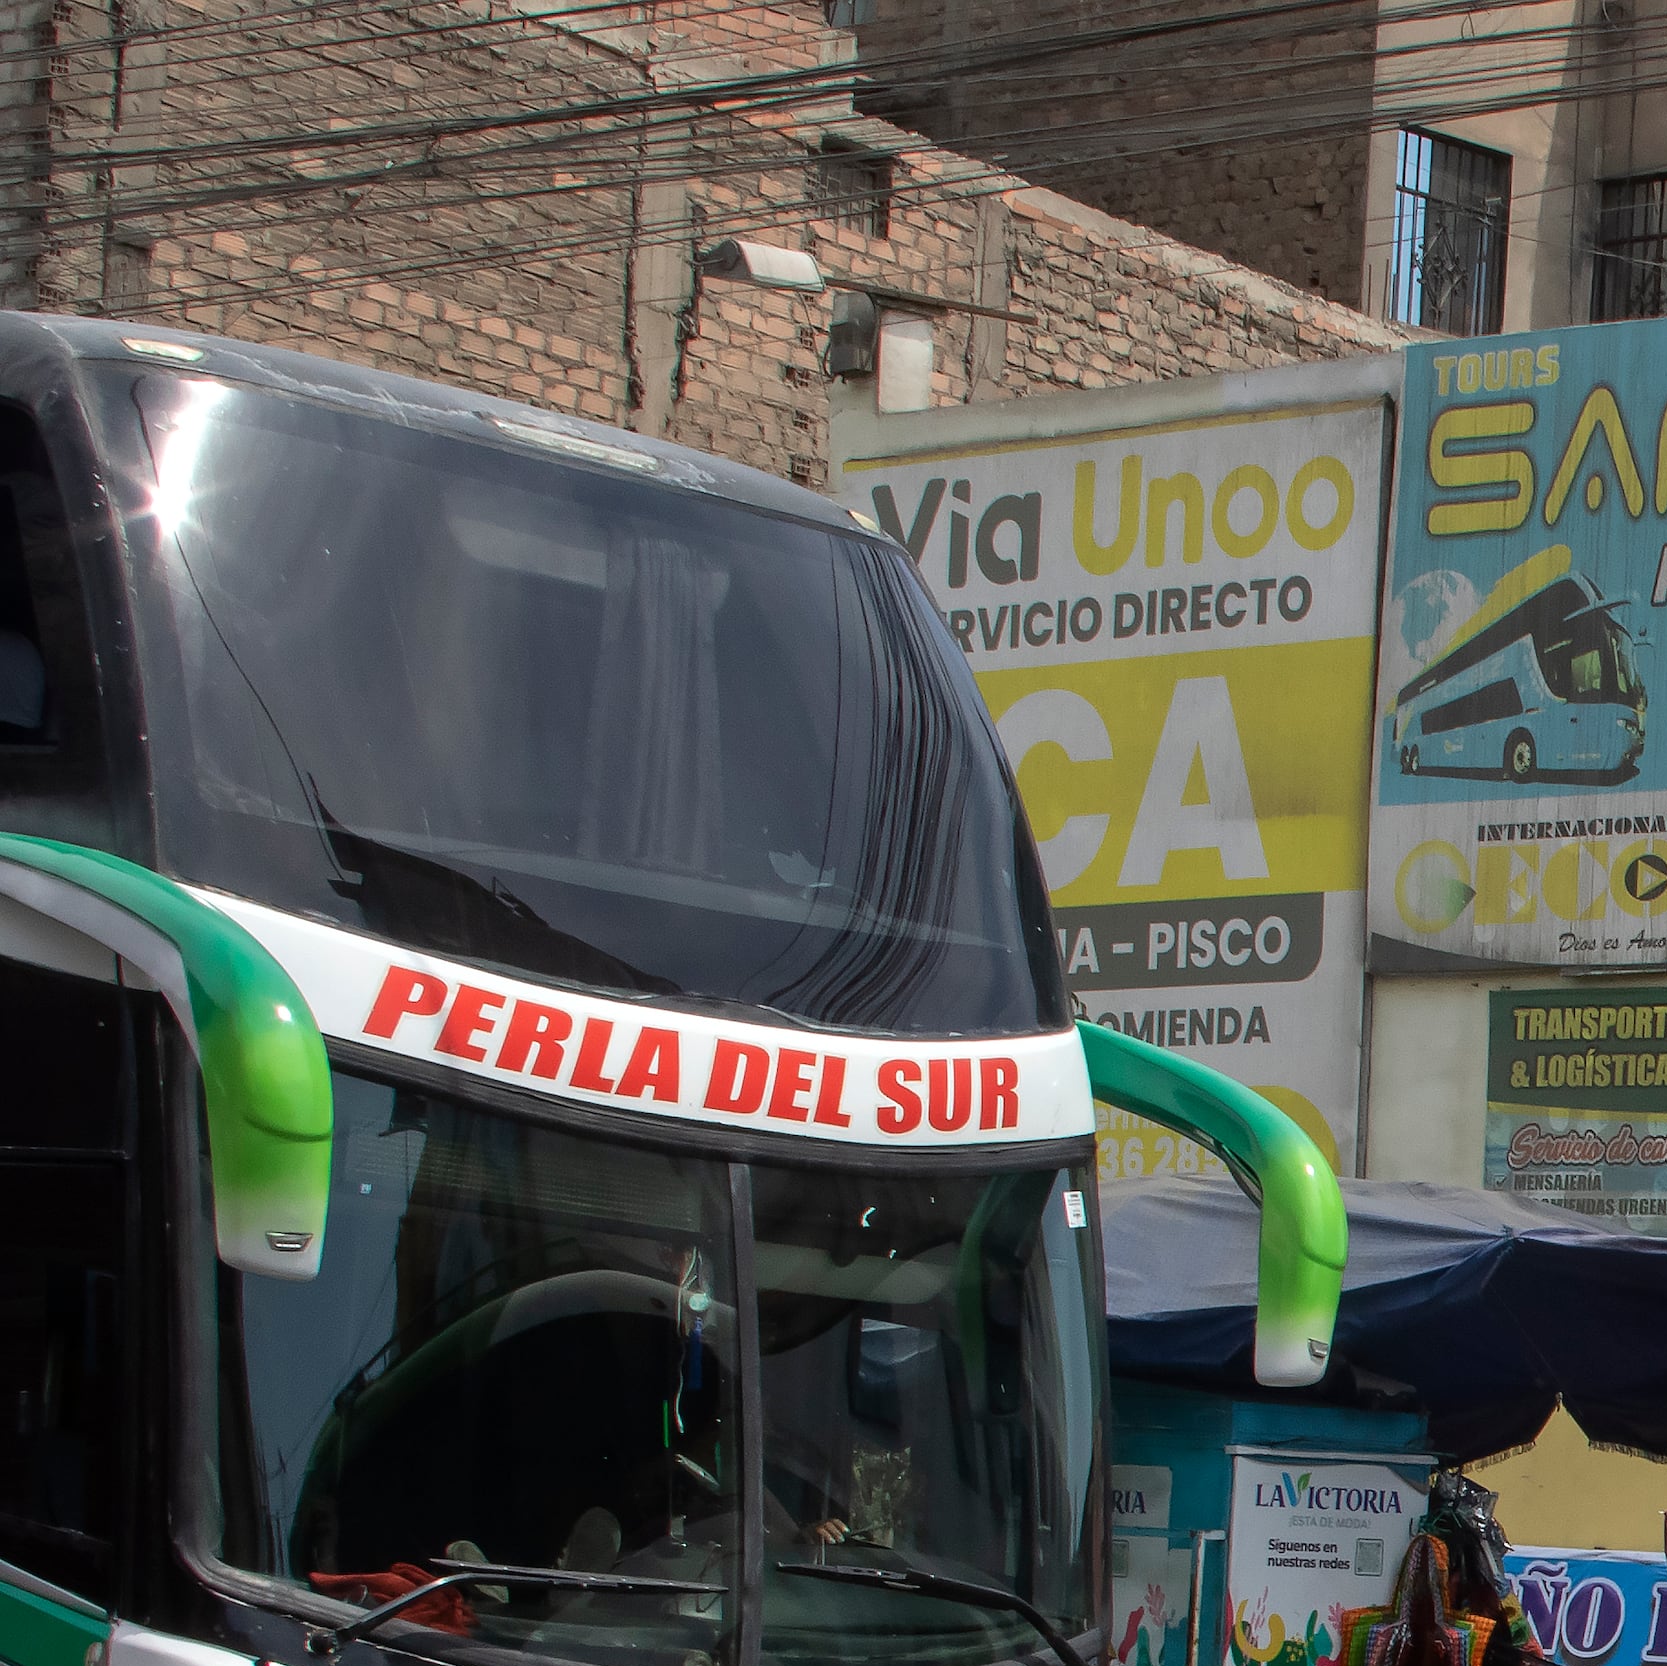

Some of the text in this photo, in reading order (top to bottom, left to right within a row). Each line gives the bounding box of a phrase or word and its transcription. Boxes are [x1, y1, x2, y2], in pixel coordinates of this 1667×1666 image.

[1433, 345, 1561, 397] TOURS
[871, 454, 1355, 589] Via Unoo
[943, 575, 1314, 654] RVICIO DIRECTO
[1147, 915, 1292, 971] PISCO
[1558, 932, 1597, 954] Dios
[362, 964, 1022, 1136] PERLA DEL SUR
[1510, 1059, 1530, 1088] &
[1507, 1123, 1605, 1169] Servicio
[1255, 1472, 1402, 1514] LA VICTORIA
[1267, 1556, 1351, 1570] nuestras redes
[1506, 1561, 1625, 1658] ÑO
